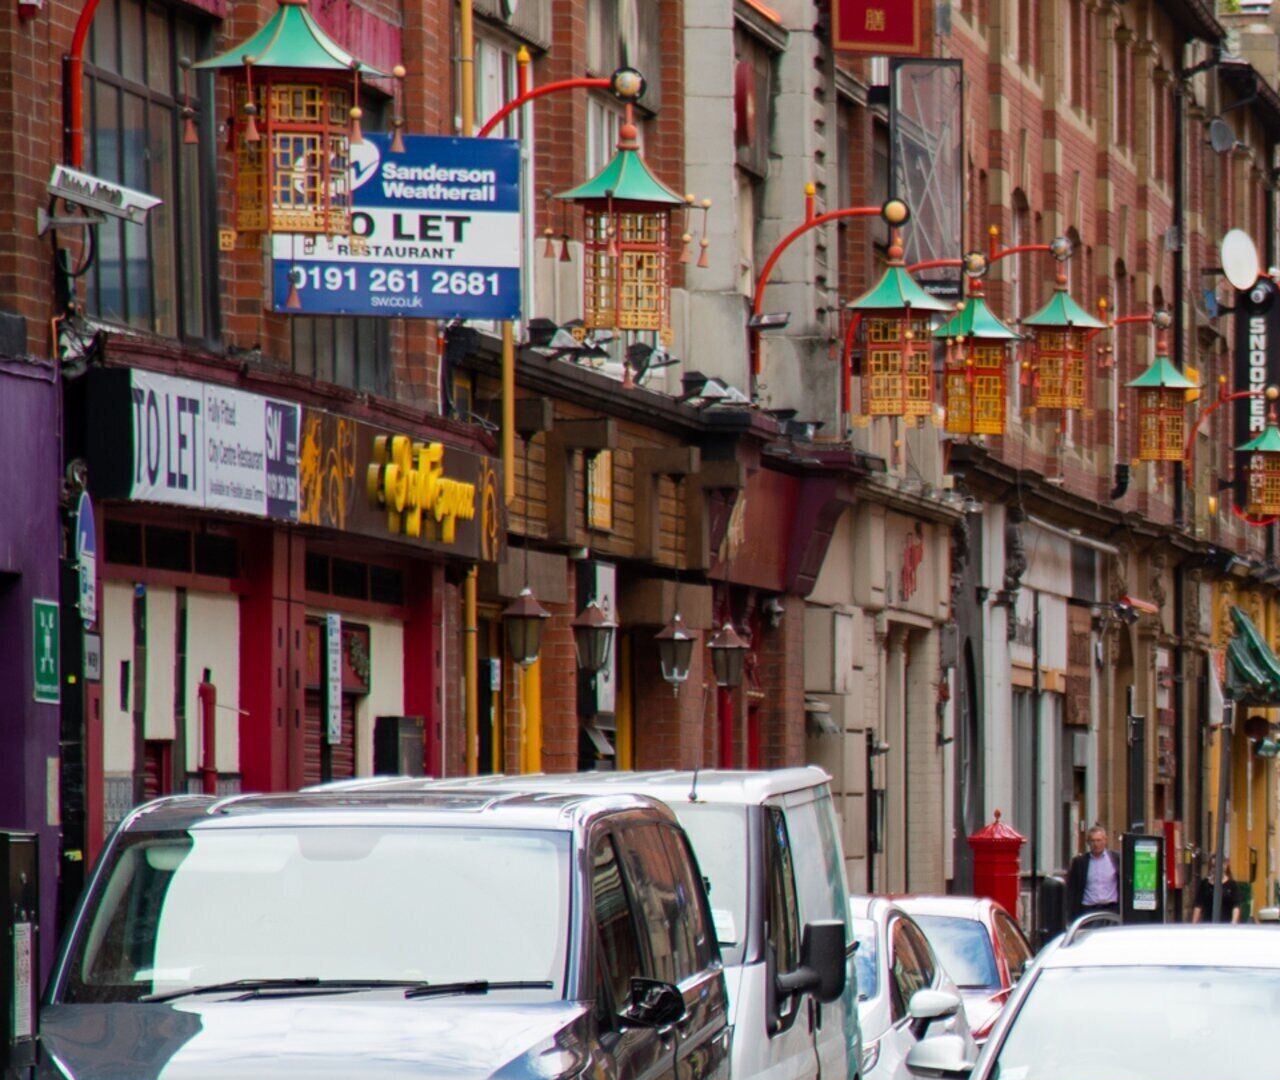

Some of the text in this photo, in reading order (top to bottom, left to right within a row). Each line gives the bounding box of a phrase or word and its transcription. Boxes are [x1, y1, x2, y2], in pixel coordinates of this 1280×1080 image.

[381, 162, 496, 183] Sanderson
[381, 182, 496, 202] Weatherall
[391, 213, 472, 243] LET
[289, 265, 500, 296] 0191 261 2681
[1249, 317, 1266, 432] SNOOKER
[131, 387, 200, 491] TO LET
